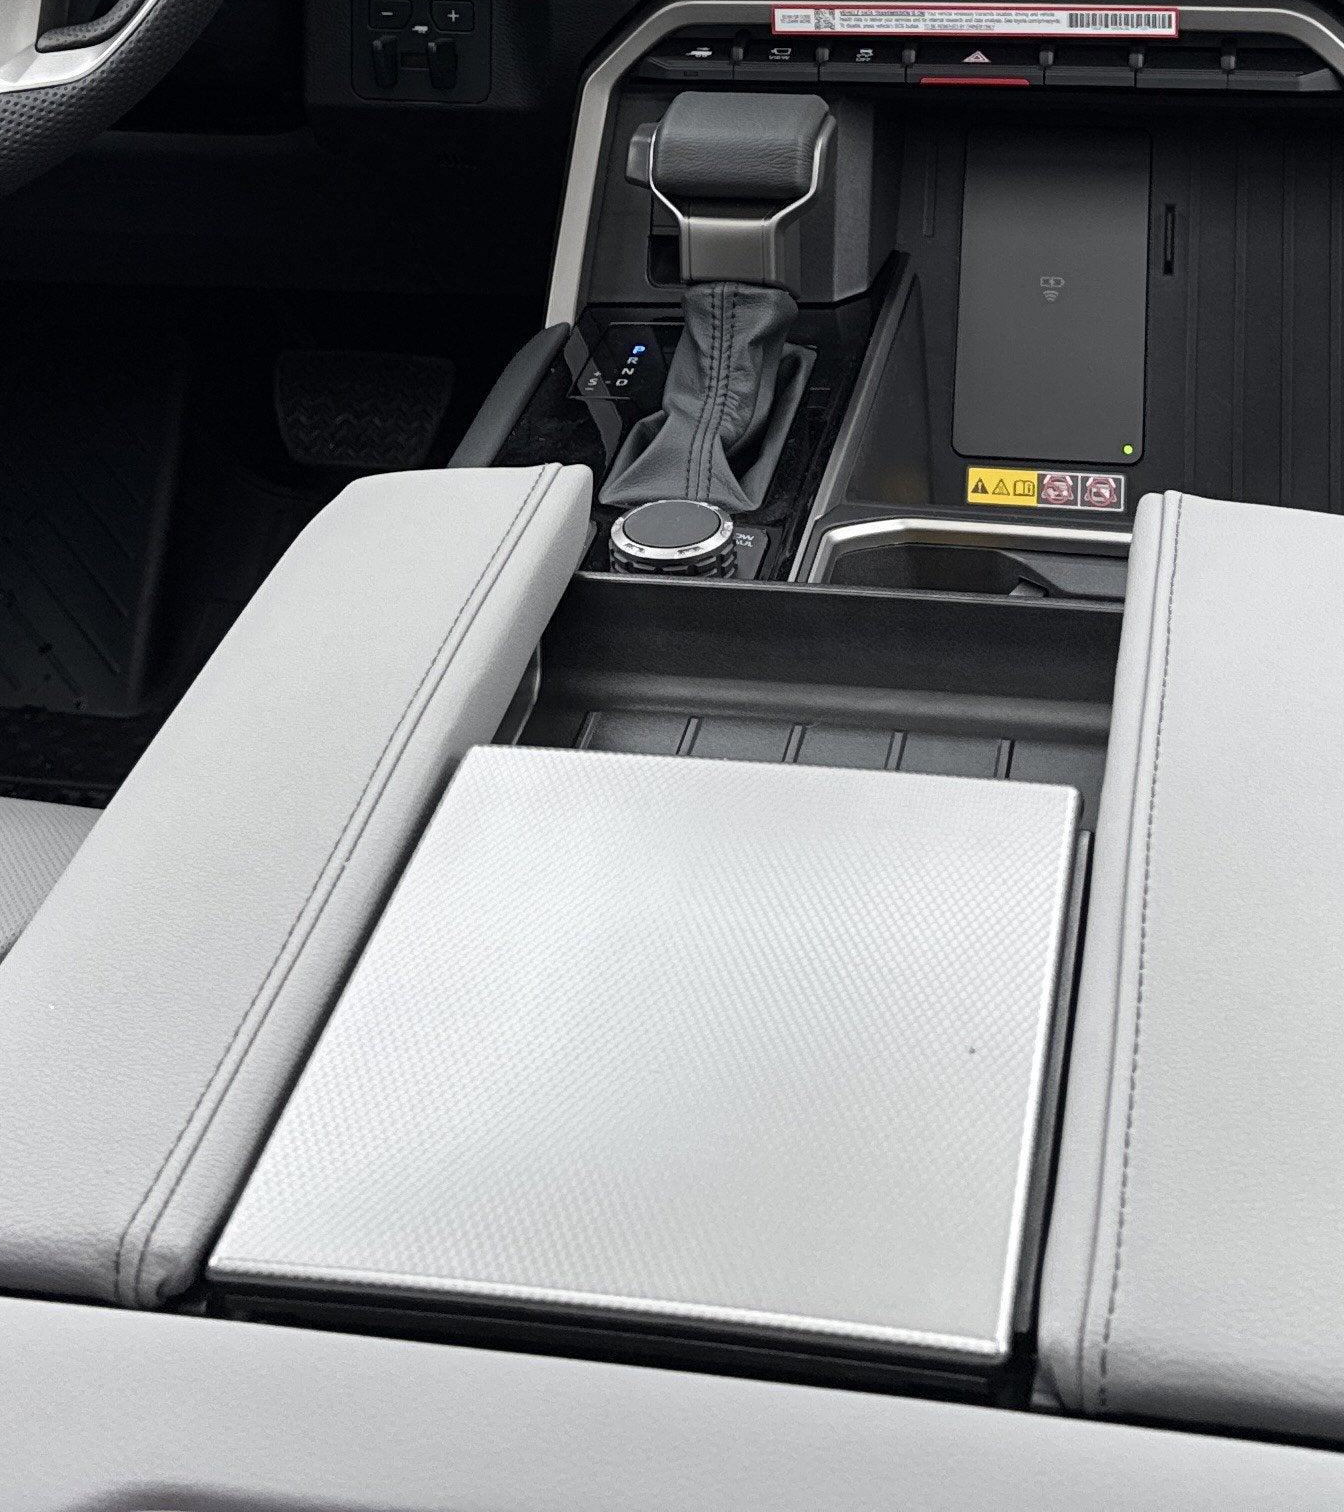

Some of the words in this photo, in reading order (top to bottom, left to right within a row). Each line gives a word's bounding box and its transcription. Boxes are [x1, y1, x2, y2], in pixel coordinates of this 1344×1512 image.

[632, 345, 646, 355] P
[627, 357, 639, 365] R
[621, 367, 634, 376] N
[615, 378, 628, 387] D
